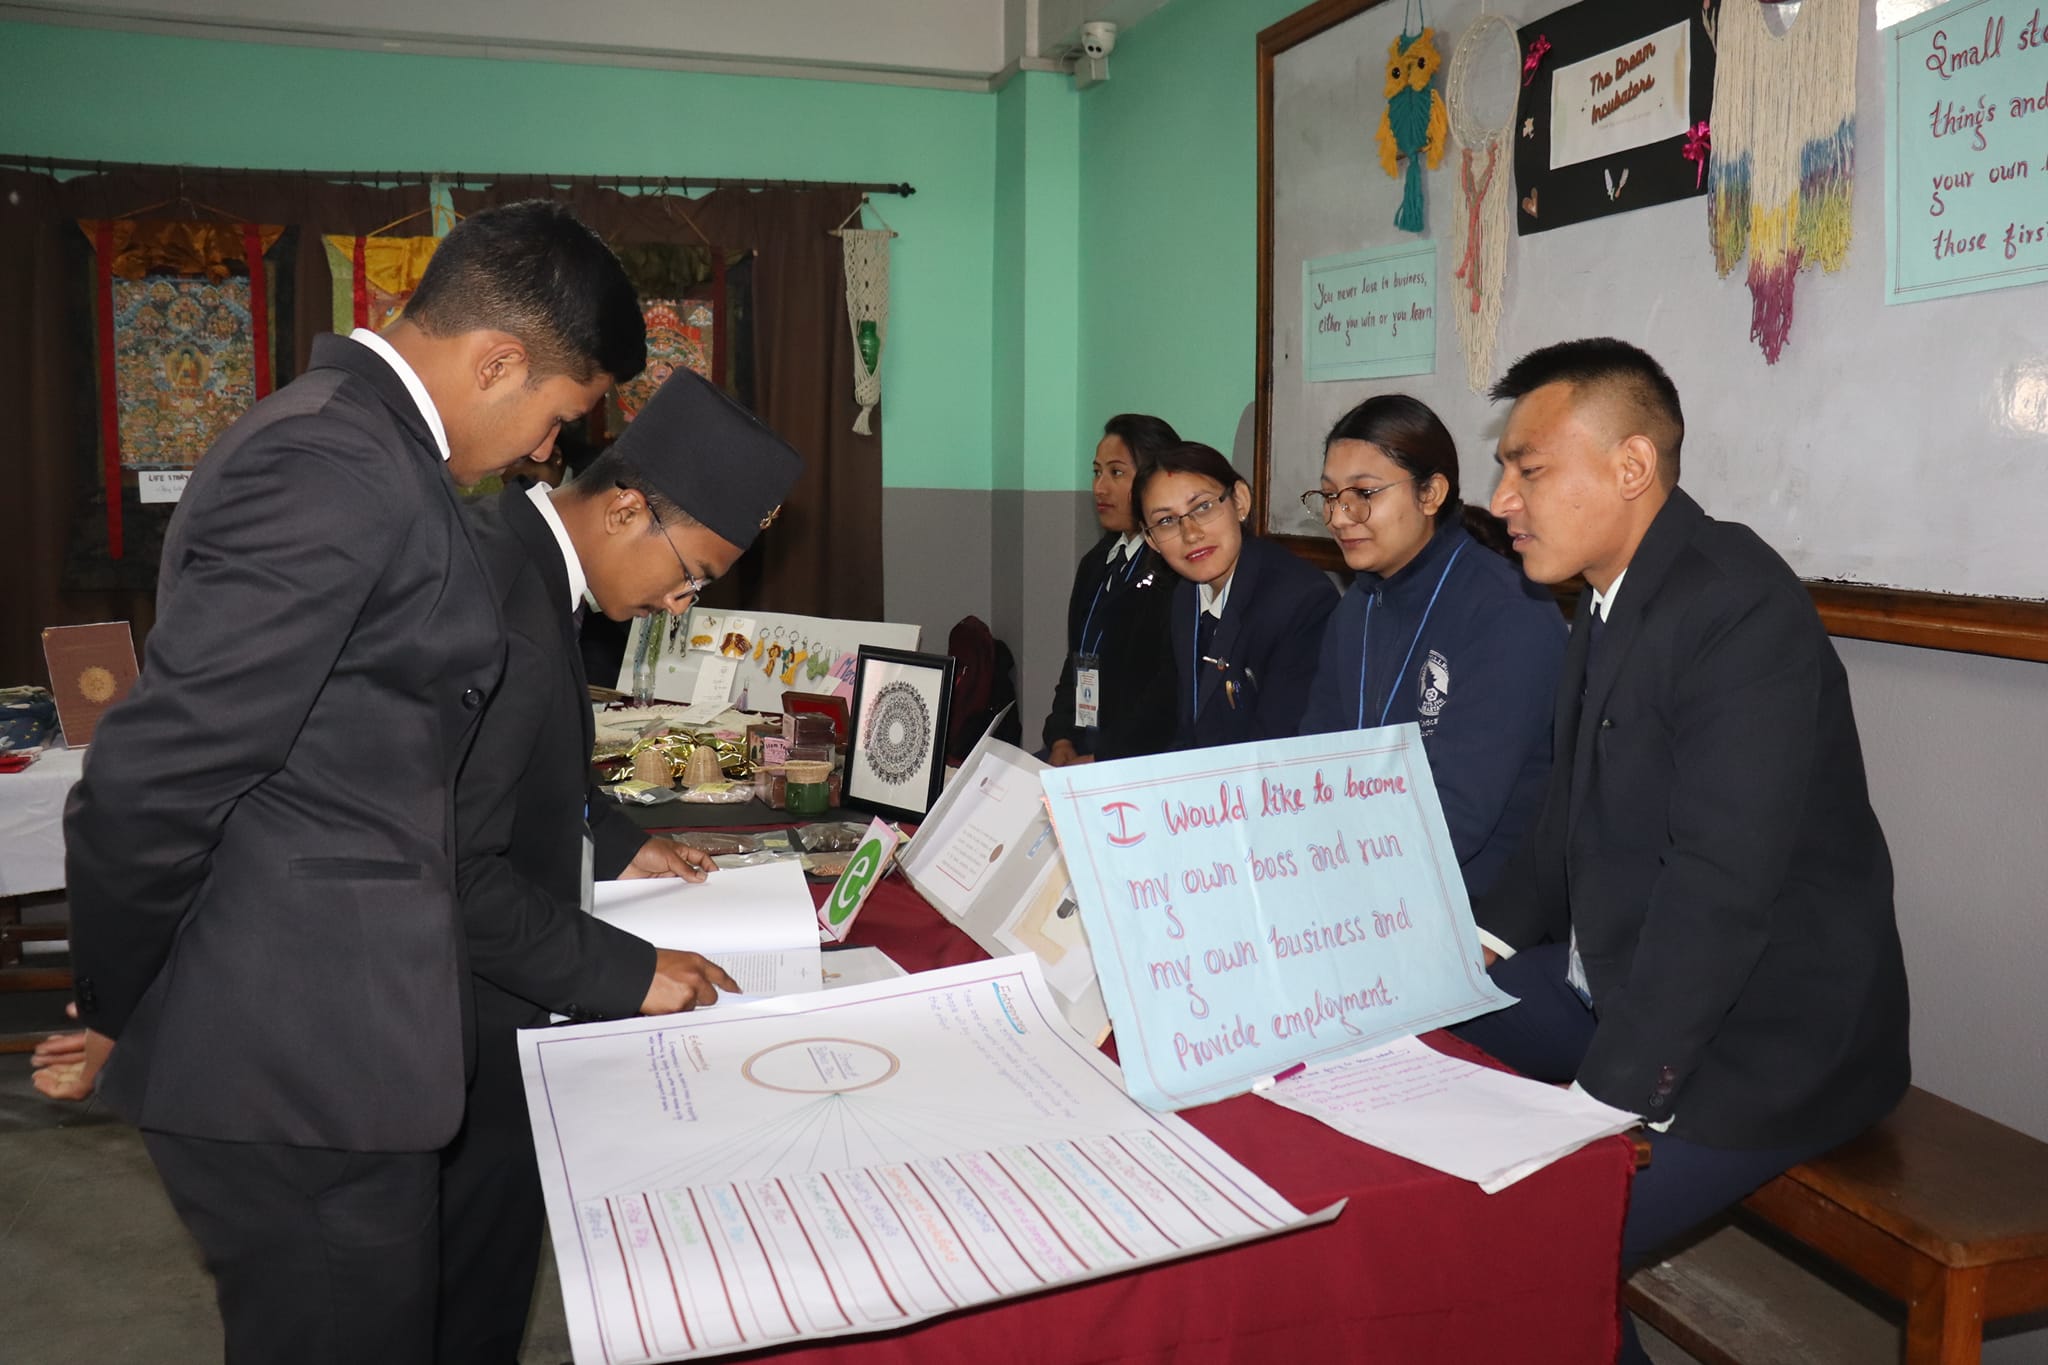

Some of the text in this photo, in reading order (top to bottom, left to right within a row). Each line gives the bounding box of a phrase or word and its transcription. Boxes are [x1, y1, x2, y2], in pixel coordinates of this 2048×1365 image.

[1615, 42, 1656, 80] Dream
[1926, 15, 2004, 80] Small
[1591, 74, 1656, 125] Incubators
[1930, 95, 1996, 151] things
[1929, 171, 1974, 217] your
[1988, 160, 2029, 184] own
[1932, 229, 1987, 261] those
[1313, 283, 1333, 310] You
[1337, 286, 1357, 302] never
[1361, 277, 1378, 294] lose
[1318, 312, 1342, 334] either
[1361, 311, 1376, 328] win
[1379, 314, 1388, 325] or
[1391, 311, 1407, 338] you
[1102, 801, 1146, 848] I
[1261, 776, 1305, 817] like
[1312, 768, 1335, 804] to
[1343, 766, 1407, 799] become
[1127, 829, 1402, 940] my own boss and run
[1148, 896, 1413, 1019] my own business and
[1173, 974, 1400, 1072] Provide employment.
